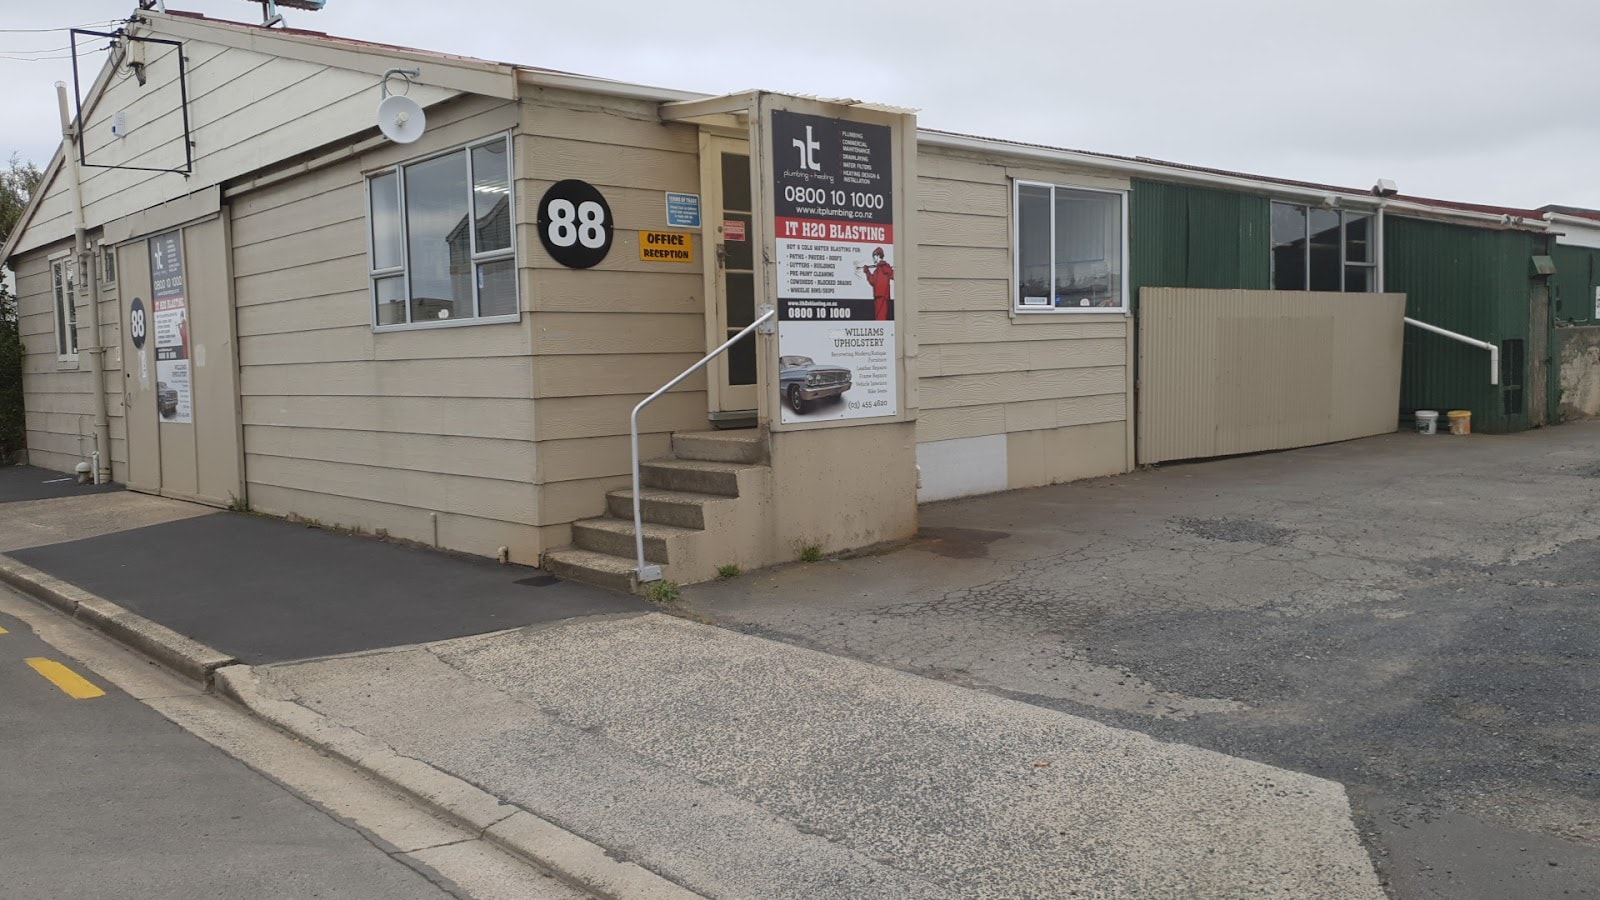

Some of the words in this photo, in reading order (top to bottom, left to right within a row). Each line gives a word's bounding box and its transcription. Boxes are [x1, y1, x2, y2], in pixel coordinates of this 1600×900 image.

[842, 139, 868, 148] COMMERCIAL
[842, 146, 870, 154] MAINTENANCE
[784, 169, 809, 182] plumbing
[814, 172, 834, 184] heating
[844, 176, 870, 184] INSTALLATION
[784, 186, 826, 204] 0800
[830, 190, 846, 206] 10
[850, 192, 884, 209] 1000
[796, 206, 873, 218] www.itplumbing.co.nz
[548, 198, 606, 248] 88
[785, 220, 798, 236] IT
[830, 224, 885, 242] BLASTING
[647, 232, 684, 246] OFFICE
[644, 248, 689, 259] RECEPTION
[788, 308, 812, 318] 0800
[816, 308, 826, 318] 10
[830, 308, 850, 318] 1000
[132, 310, 144, 338] 88
[844, 328, 884, 336] WILLIAMS
[834, 338, 885, 348] UPHOLSTERY
[848, 400, 860, 410] (03)
[862, 400, 872, 408] 455
